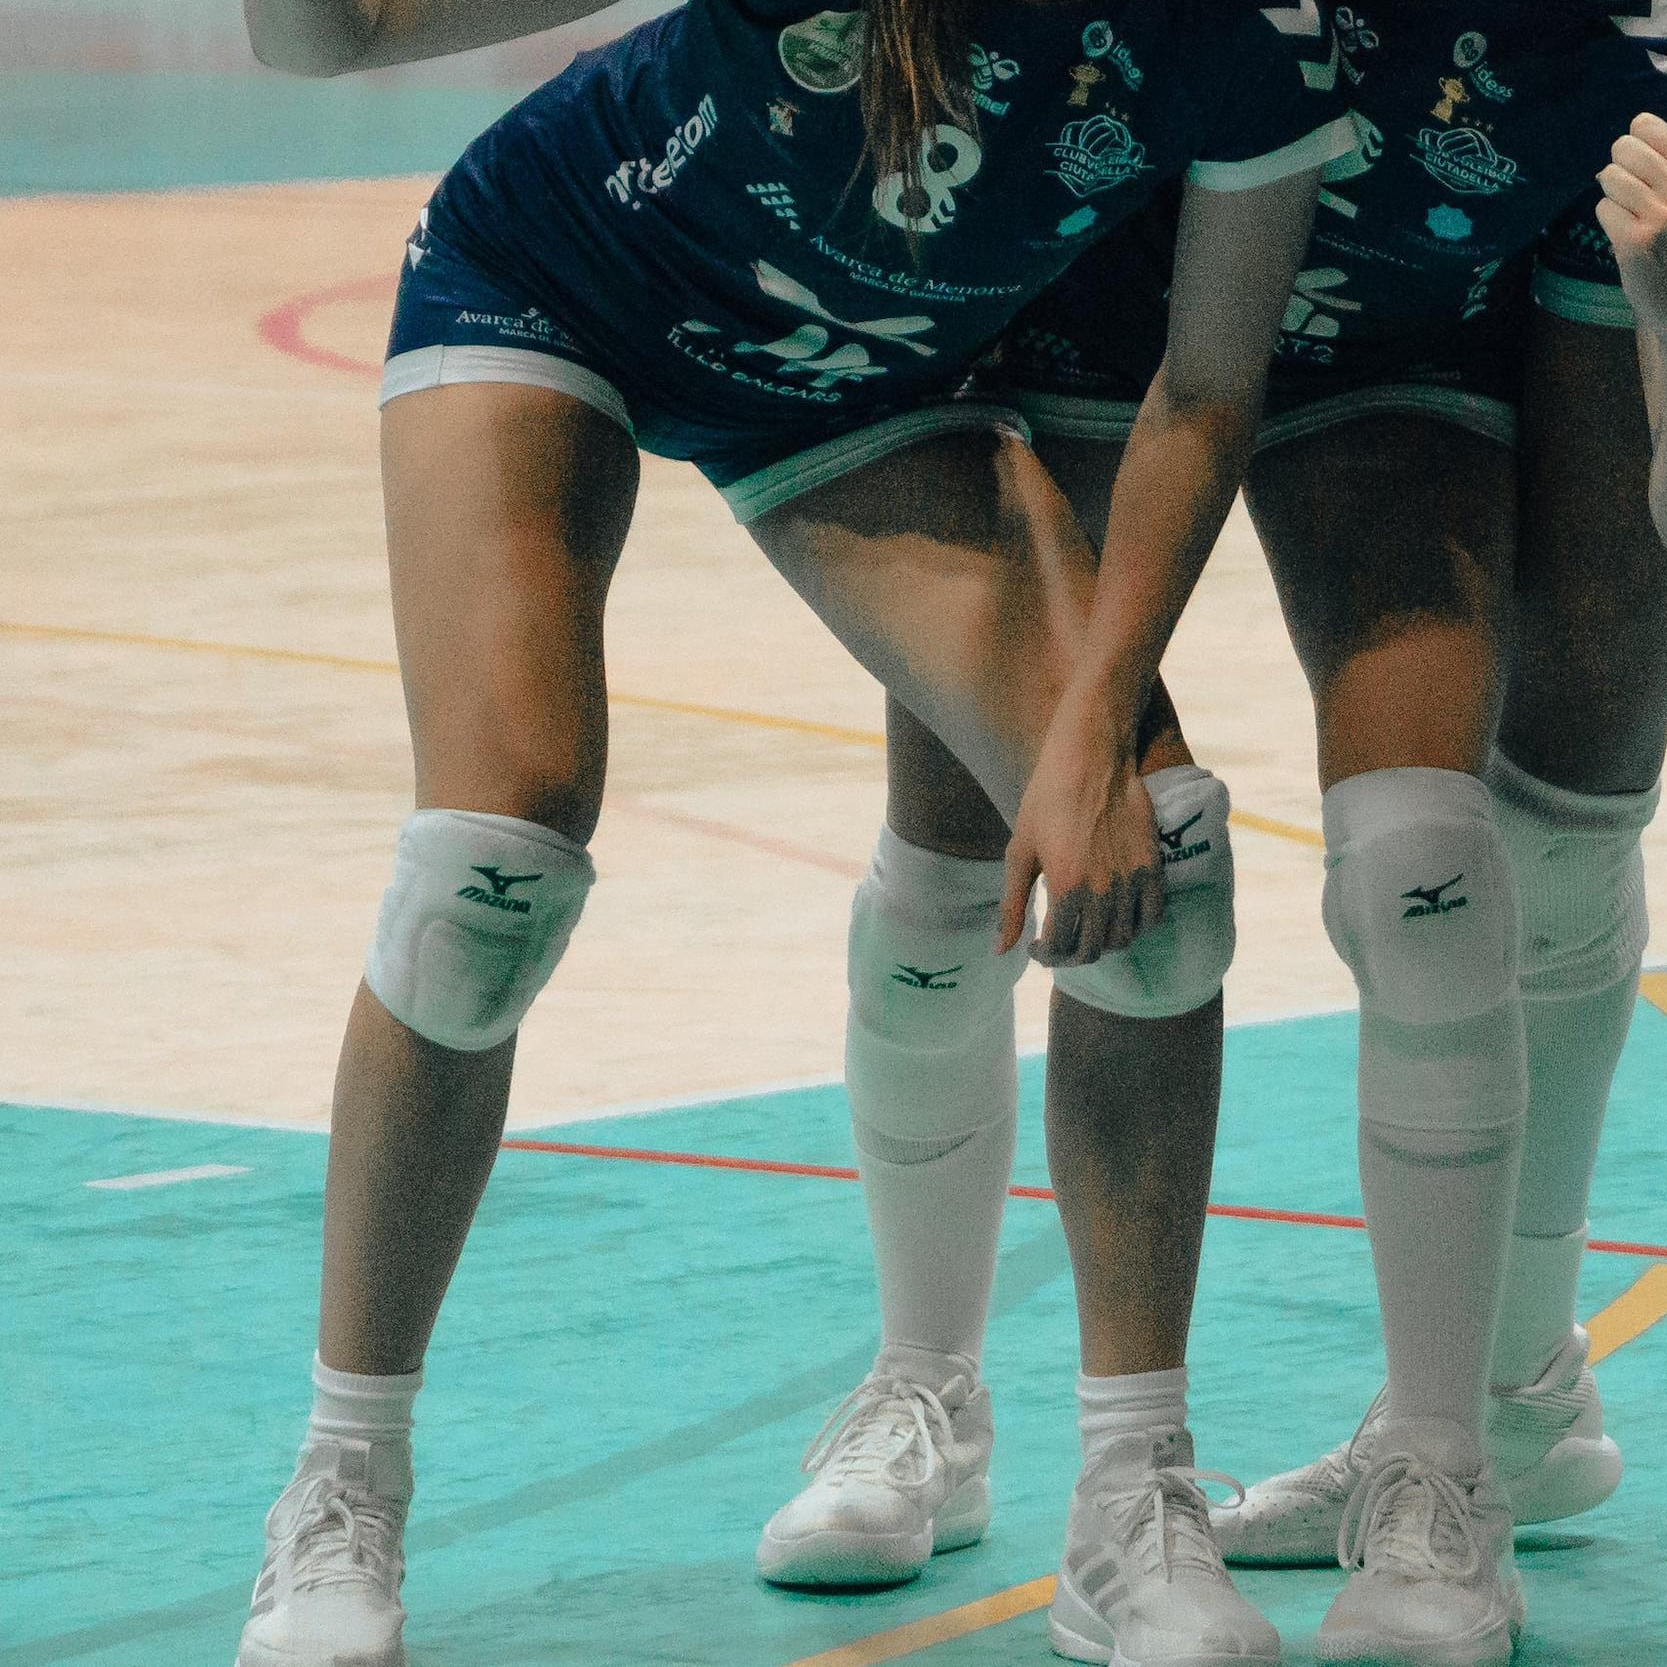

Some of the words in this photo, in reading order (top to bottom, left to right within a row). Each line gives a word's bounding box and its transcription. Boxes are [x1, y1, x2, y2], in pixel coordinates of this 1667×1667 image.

[872, 123, 983, 234] 8
[808, 234, 891, 280] Avarca
[456, 309, 525, 329] Avarca
[498, 327, 537, 341] MARCA
